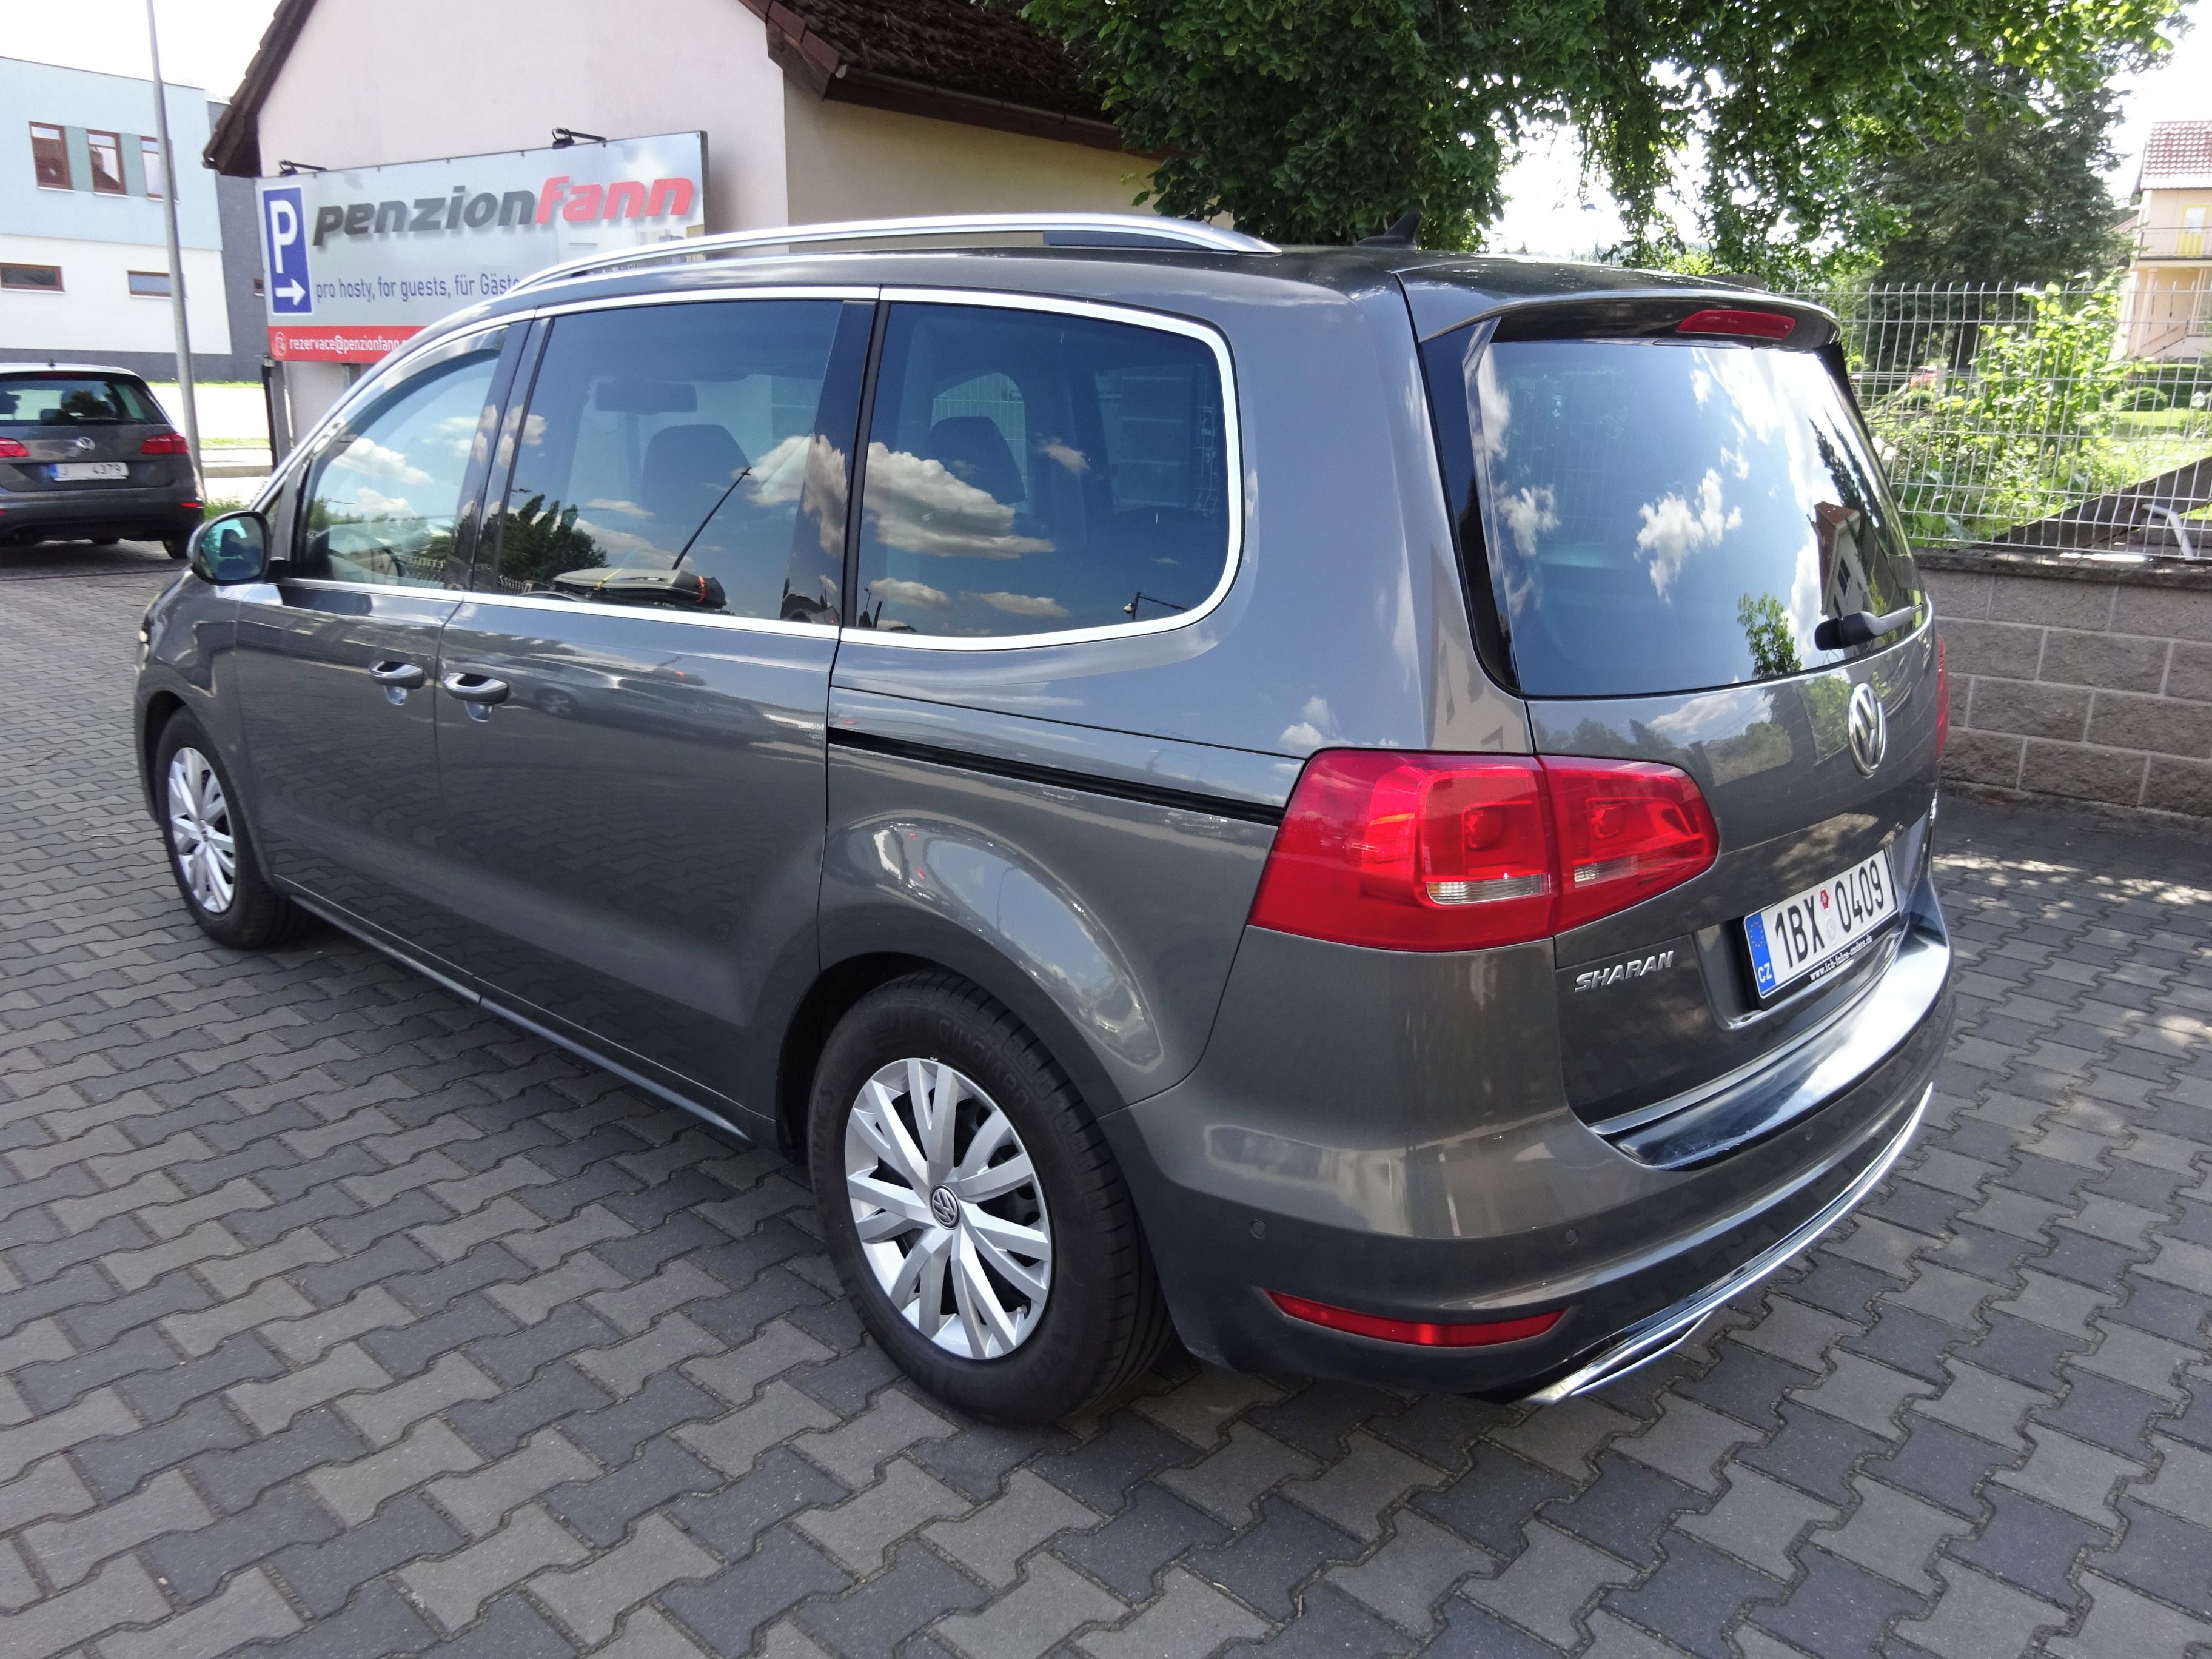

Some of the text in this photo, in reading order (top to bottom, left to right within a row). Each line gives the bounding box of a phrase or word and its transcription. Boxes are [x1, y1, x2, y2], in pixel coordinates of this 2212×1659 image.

[269, 199, 298, 274] P
[312, 175, 694, 246] penzionfann
[315, 283, 335, 303] pro
[339, 277, 375, 303] hosty,
[378, 276, 396, 298] for
[400, 276, 451, 302] guests,
[455, 274, 475, 296] für
[1774, 858, 1884, 968] 1BX 0409
[1574, 950, 1674, 993] SHARAN
[1757, 962, 1772, 984] CZ
